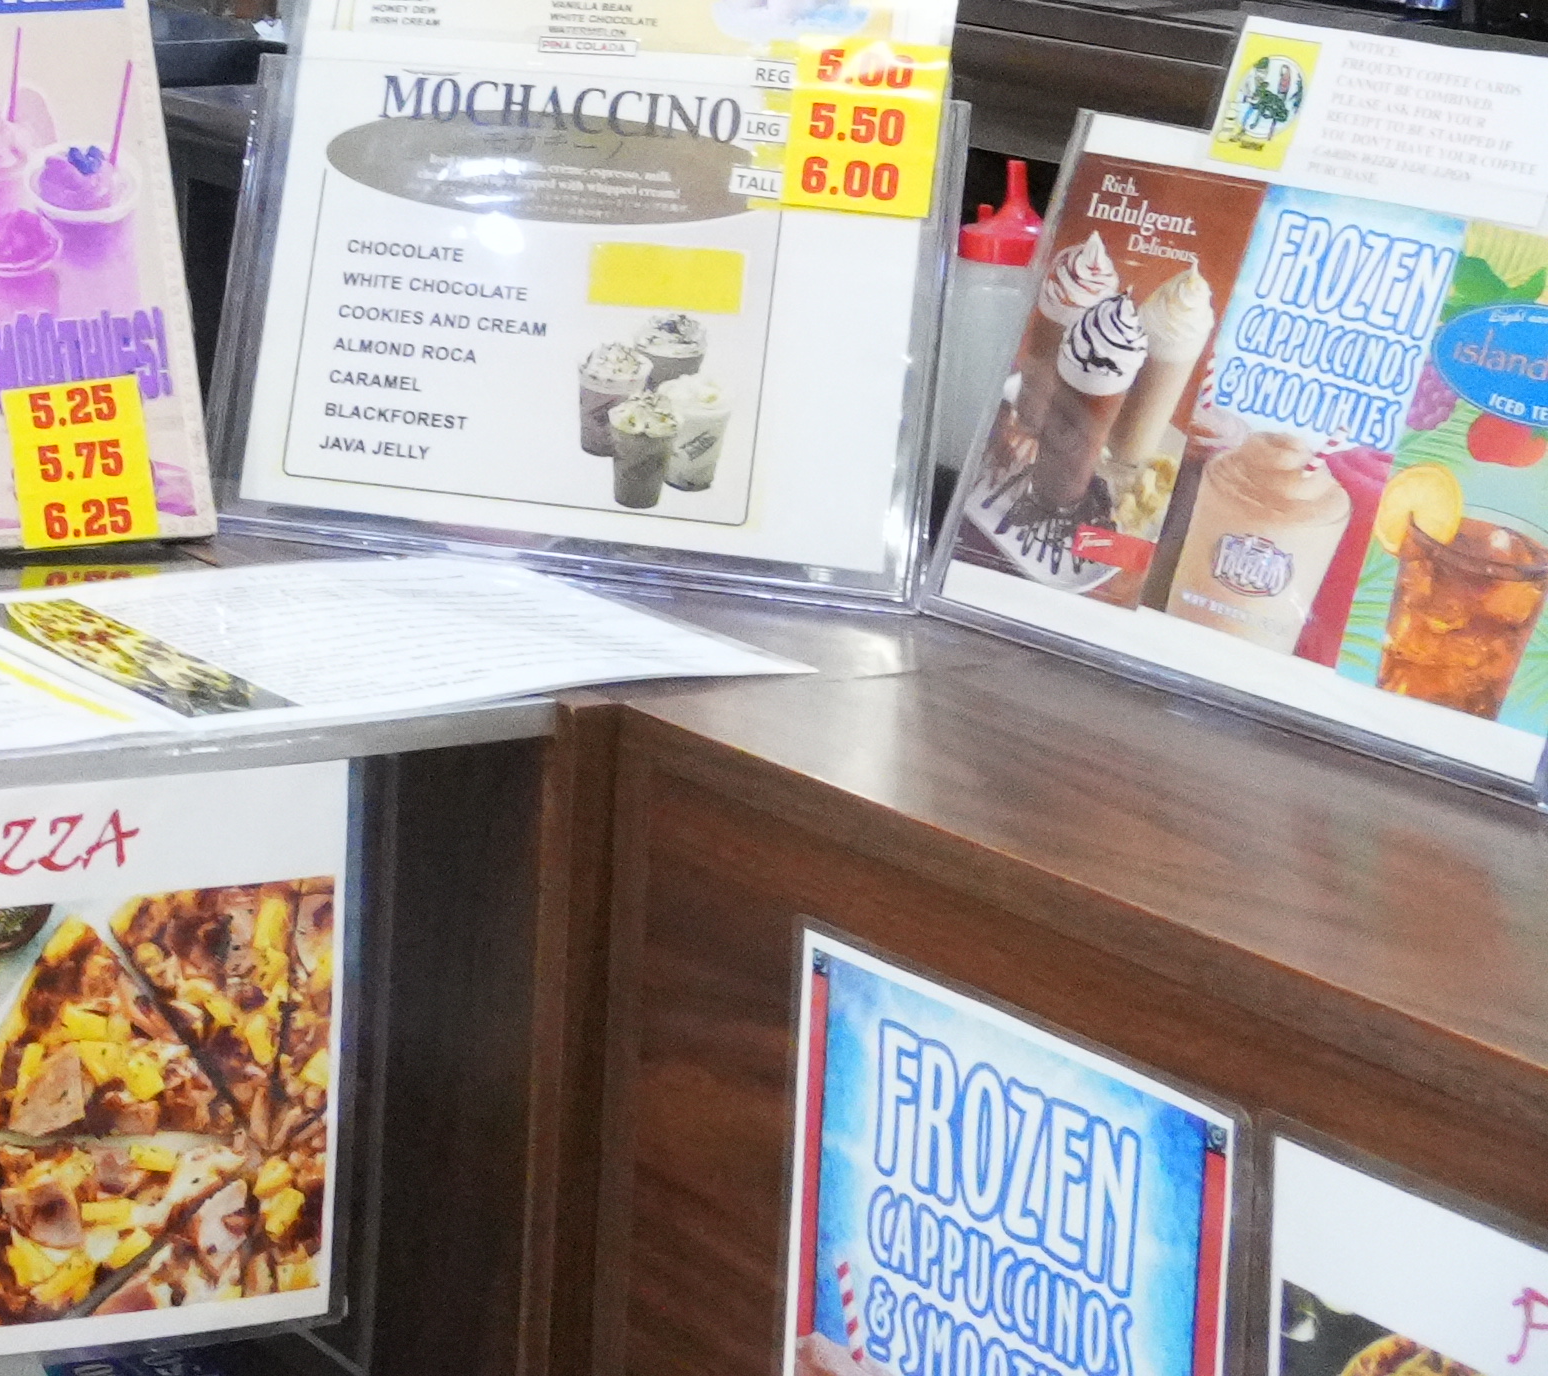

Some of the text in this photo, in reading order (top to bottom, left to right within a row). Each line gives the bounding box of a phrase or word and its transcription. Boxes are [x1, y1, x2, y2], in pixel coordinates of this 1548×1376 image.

[381, 73, 740, 144] MOCHACCINO
[1102, 175, 1138, 196] Rich.
[1087, 193, 1196, 236] Indulgent.
[343, 272, 527, 301] WHITE CHOCOLATE
[1256, 209, 1459, 341] FROZEN
[1235, 304, 1422, 396] CAPPUCCINOS
[30, 385, 115, 428] 5.25
[1216, 357, 1402, 451] & SMOOTHIES
[38, 439, 123, 482] 5.75
[45, 497, 131, 539] 6.25
[875, 1022, 1140, 1298] FROZEN
[869, 1184, 1133, 1376] CAPPUCCINOS
